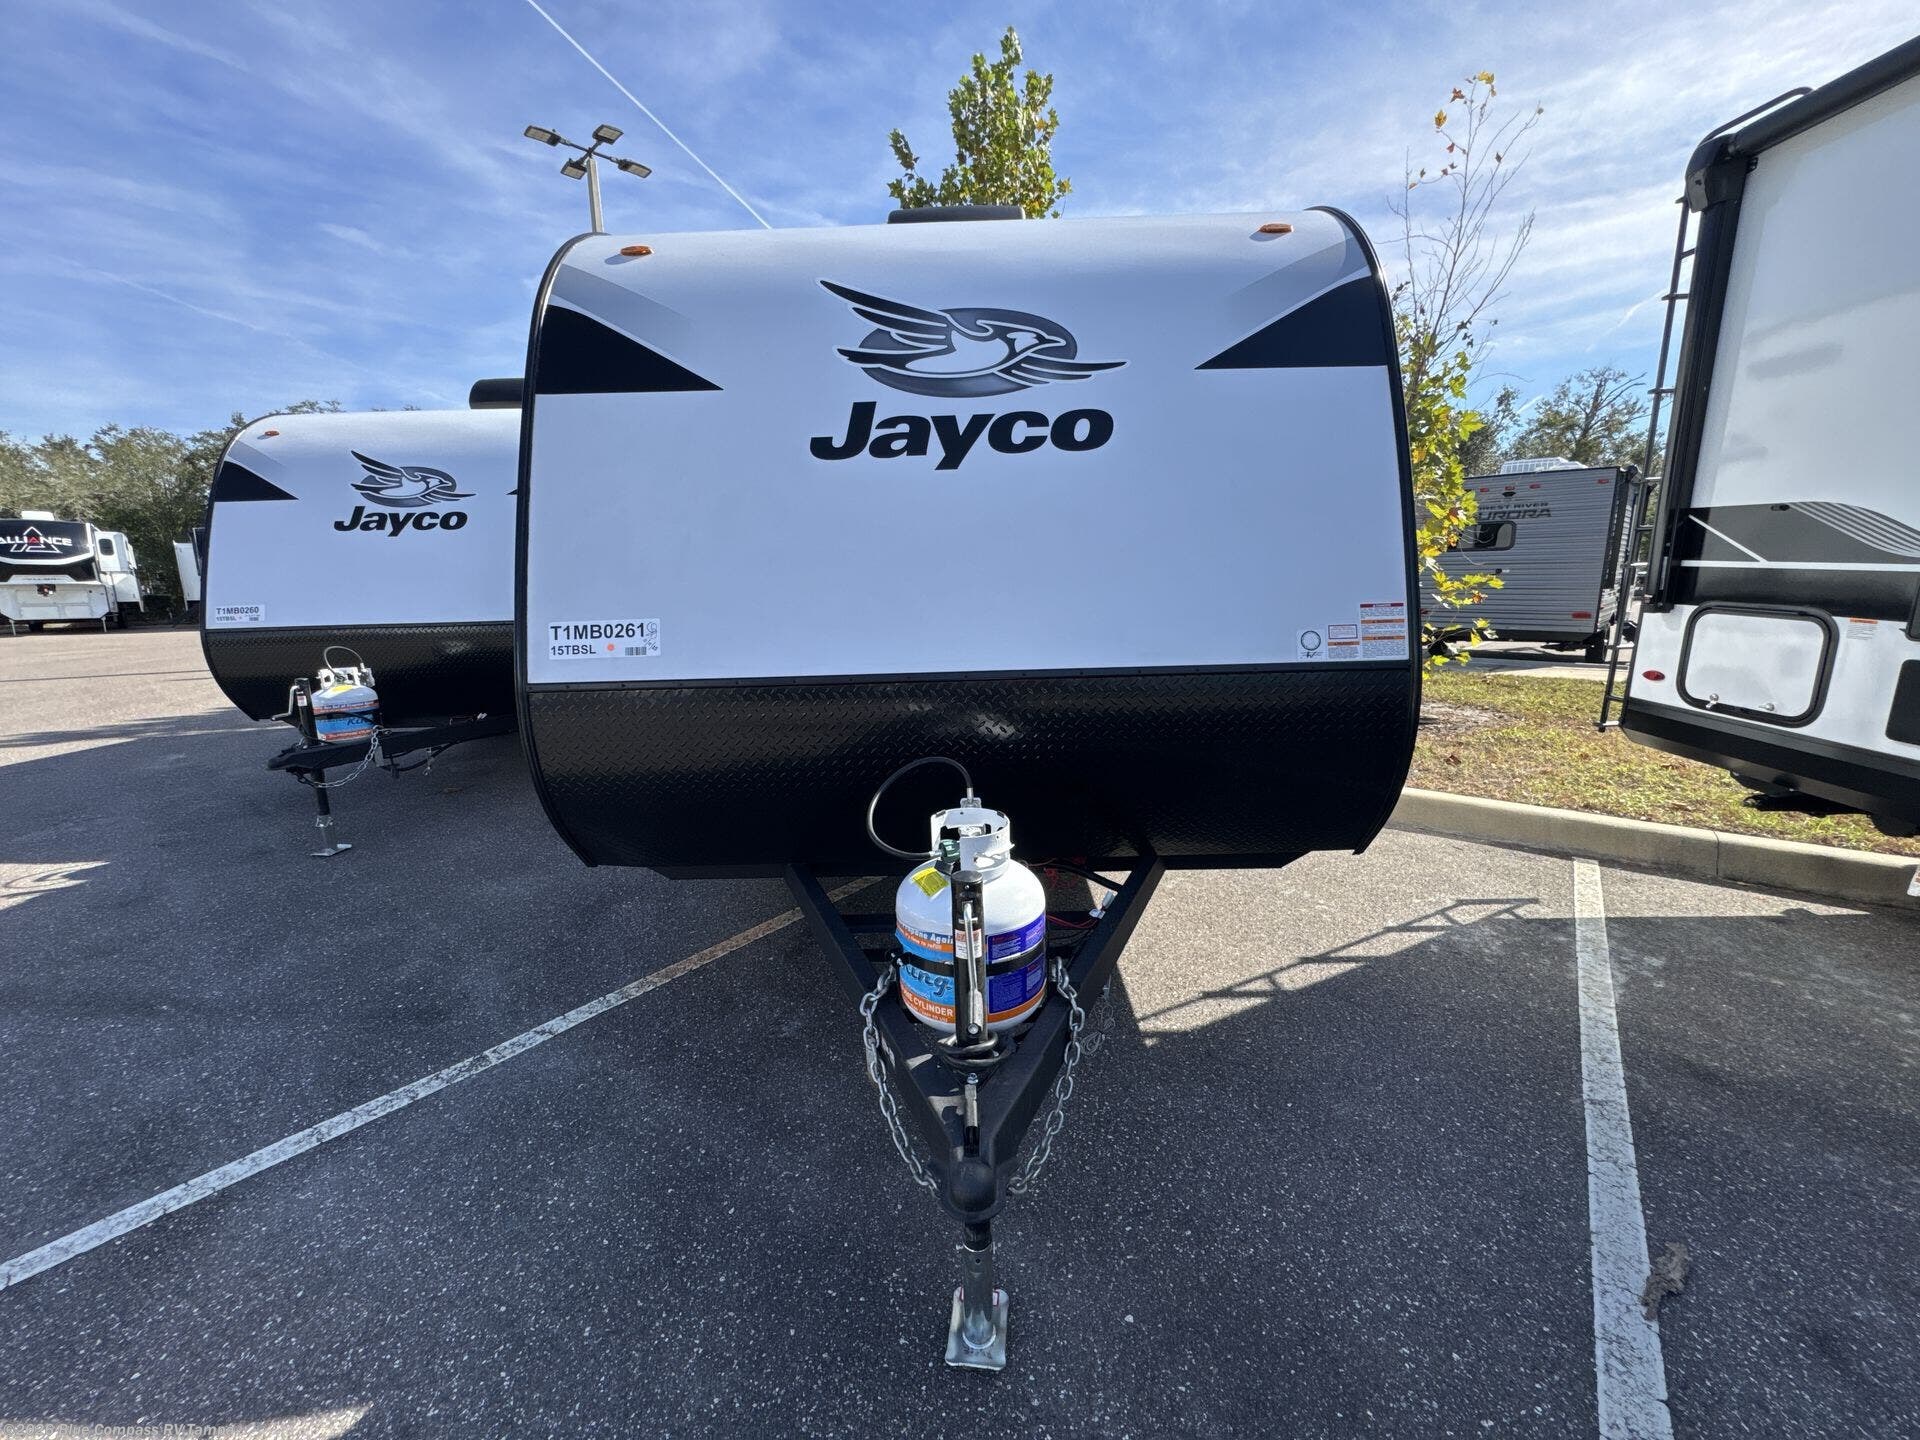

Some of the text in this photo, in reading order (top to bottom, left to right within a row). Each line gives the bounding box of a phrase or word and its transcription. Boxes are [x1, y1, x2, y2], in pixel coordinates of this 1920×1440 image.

[810, 401, 1114, 471] Jayco
[334, 505, 468, 537] Jayco
[1478, 508, 1553, 520] URORA
[0, 535, 73, 547] ALLIANCE
[216, 606, 260, 615] T1MB0260
[550, 622, 645, 641] T1MB0261
[550, 644, 597, 656] 15TBSL
[913, 998, 954, 1017] CYLINDER
